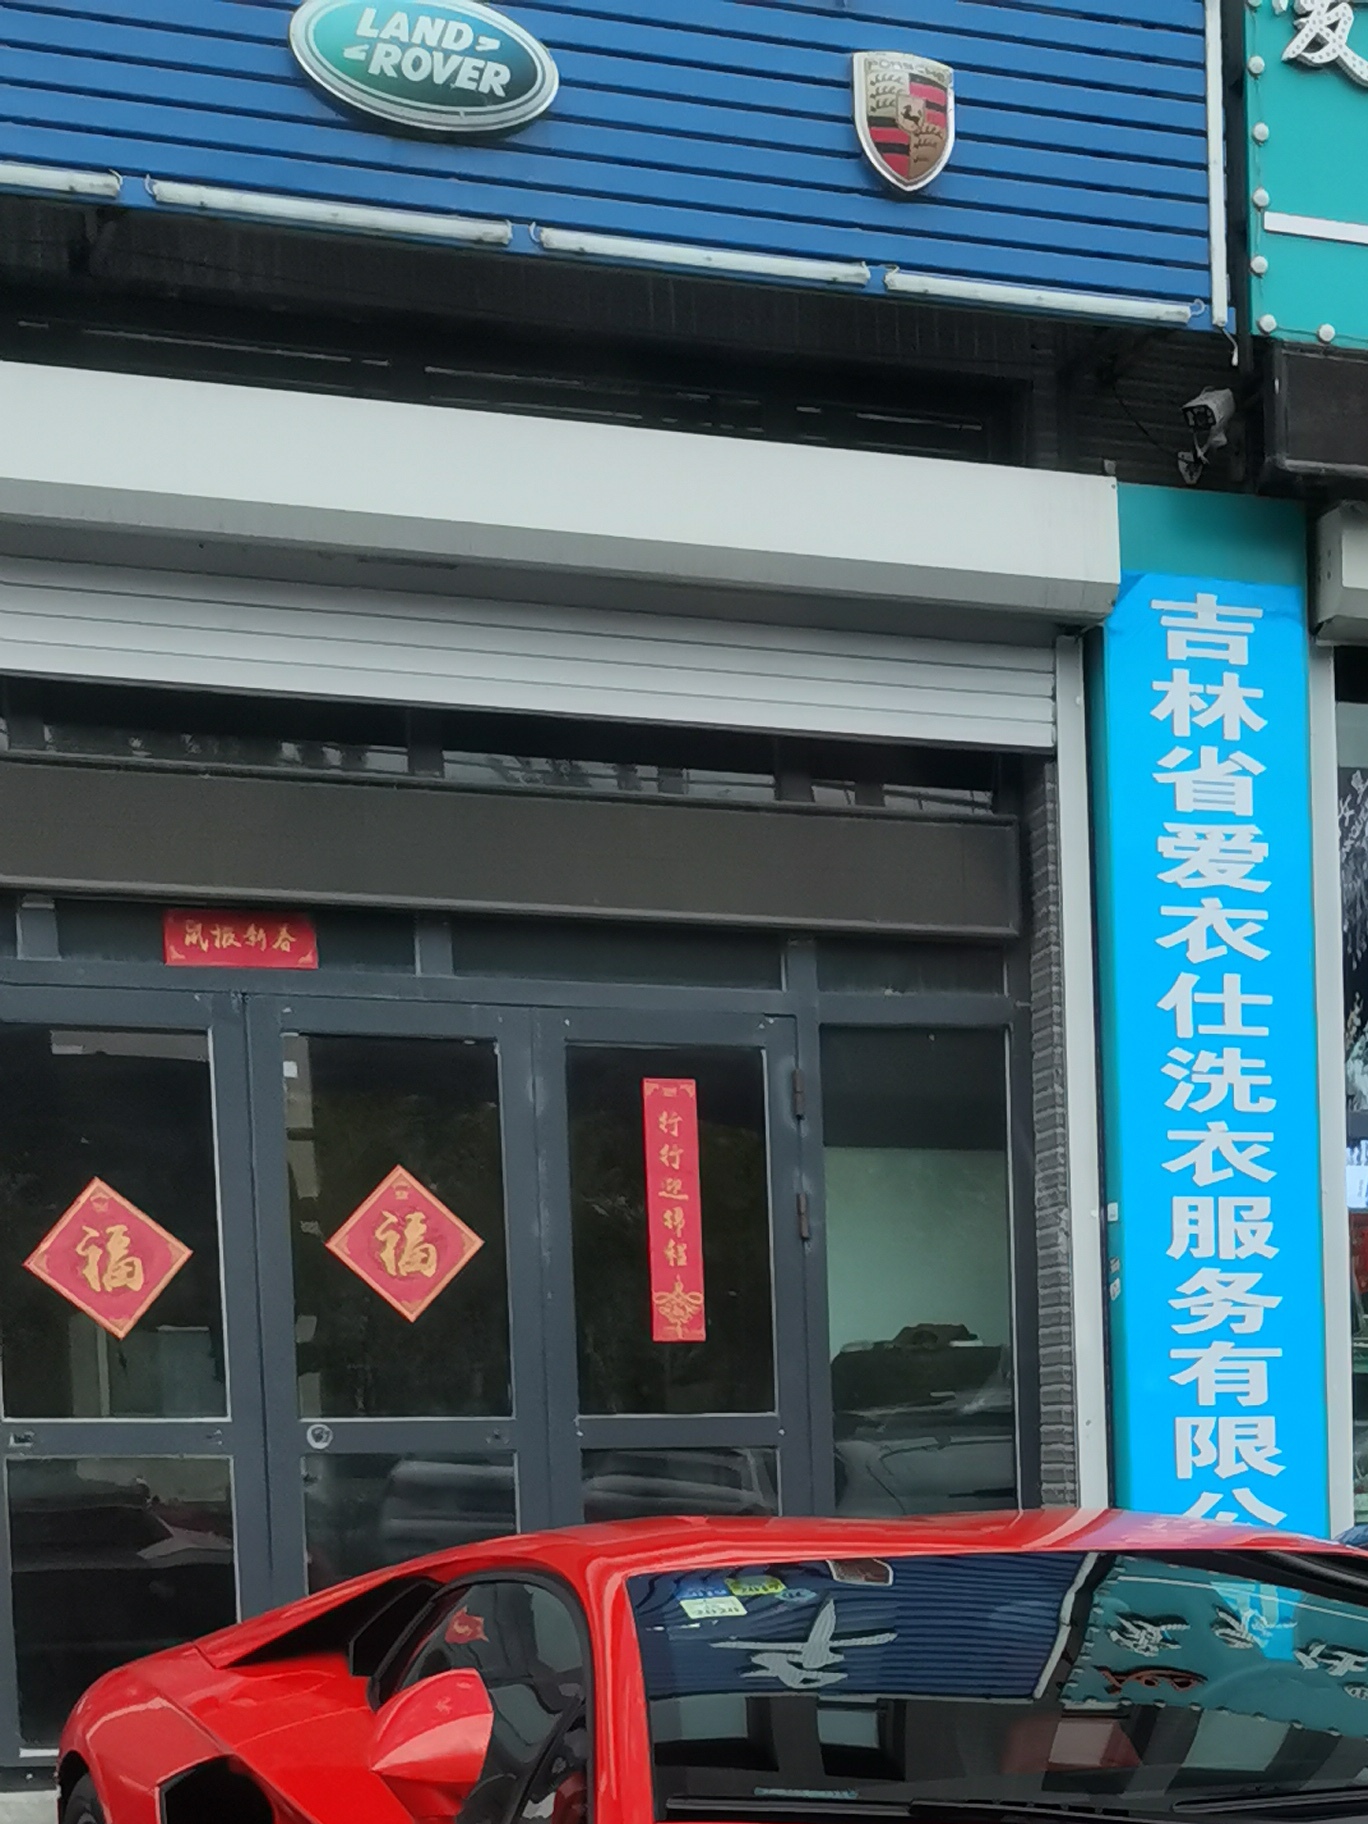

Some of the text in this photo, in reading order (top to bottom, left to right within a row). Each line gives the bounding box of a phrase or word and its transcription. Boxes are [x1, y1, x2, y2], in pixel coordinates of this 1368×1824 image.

[356, 7, 474, 51] LAND
[367, 43, 512, 97] ROVER
[75, 1224, 144, 1293] 福
[374, 1211, 438, 1278] 福
